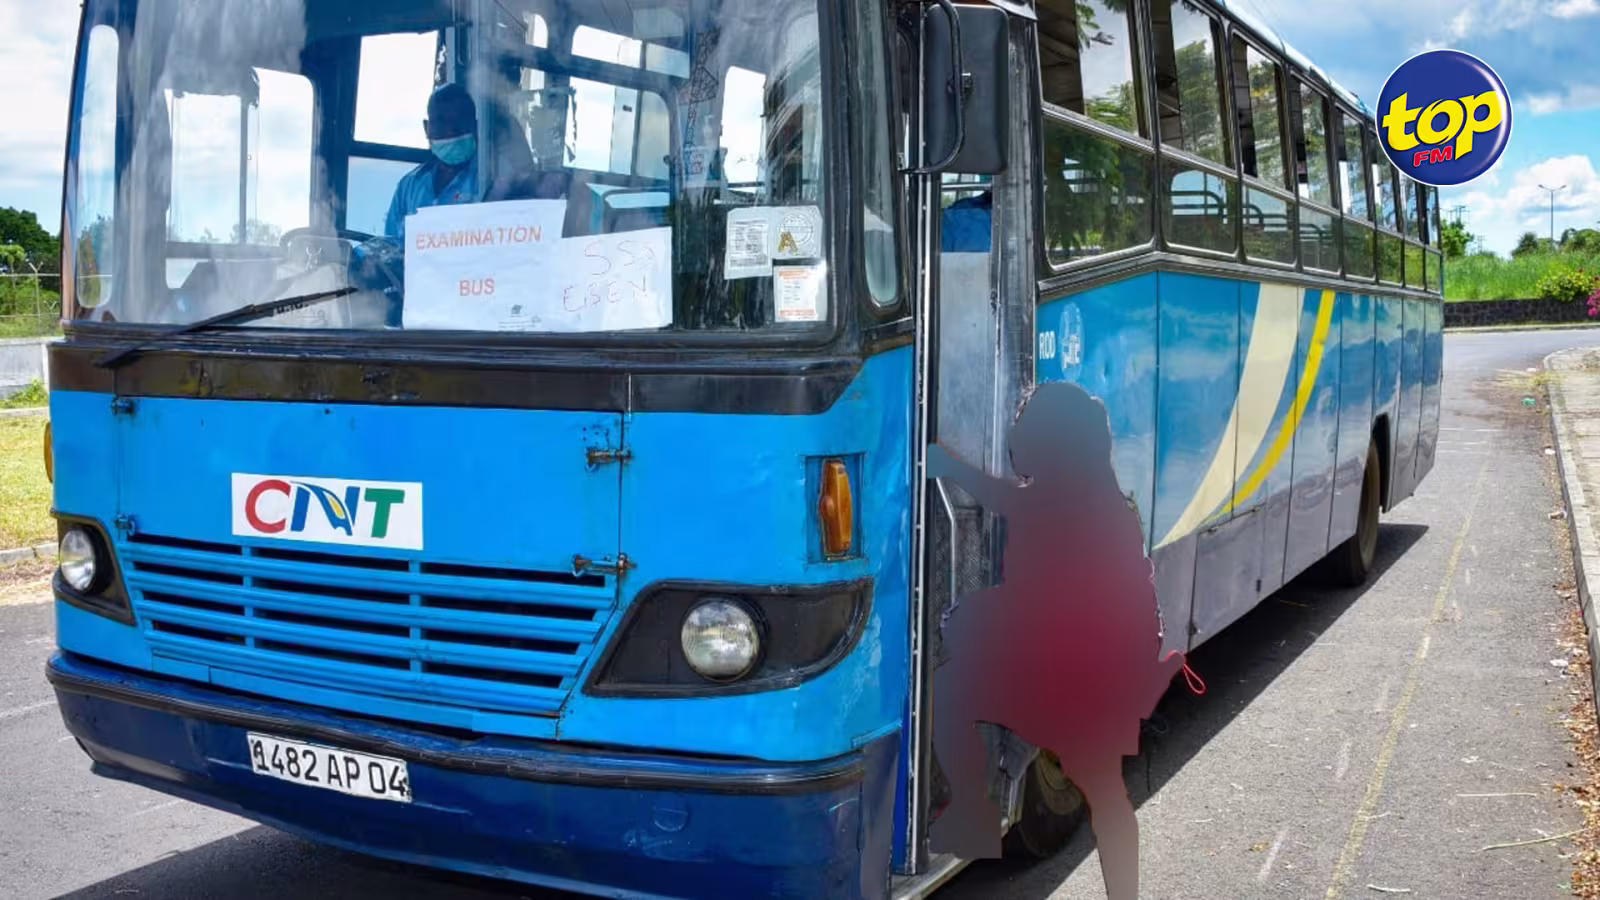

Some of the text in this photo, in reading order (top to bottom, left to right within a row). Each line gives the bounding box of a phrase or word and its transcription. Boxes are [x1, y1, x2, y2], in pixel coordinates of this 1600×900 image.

[415, 226, 542, 250] EXAMINATION
[778, 230, 798, 253] A
[459, 278, 495, 296] BUS
[245, 479, 405, 539] CNT
[253, 740, 408, 796] 1482 AP 04
